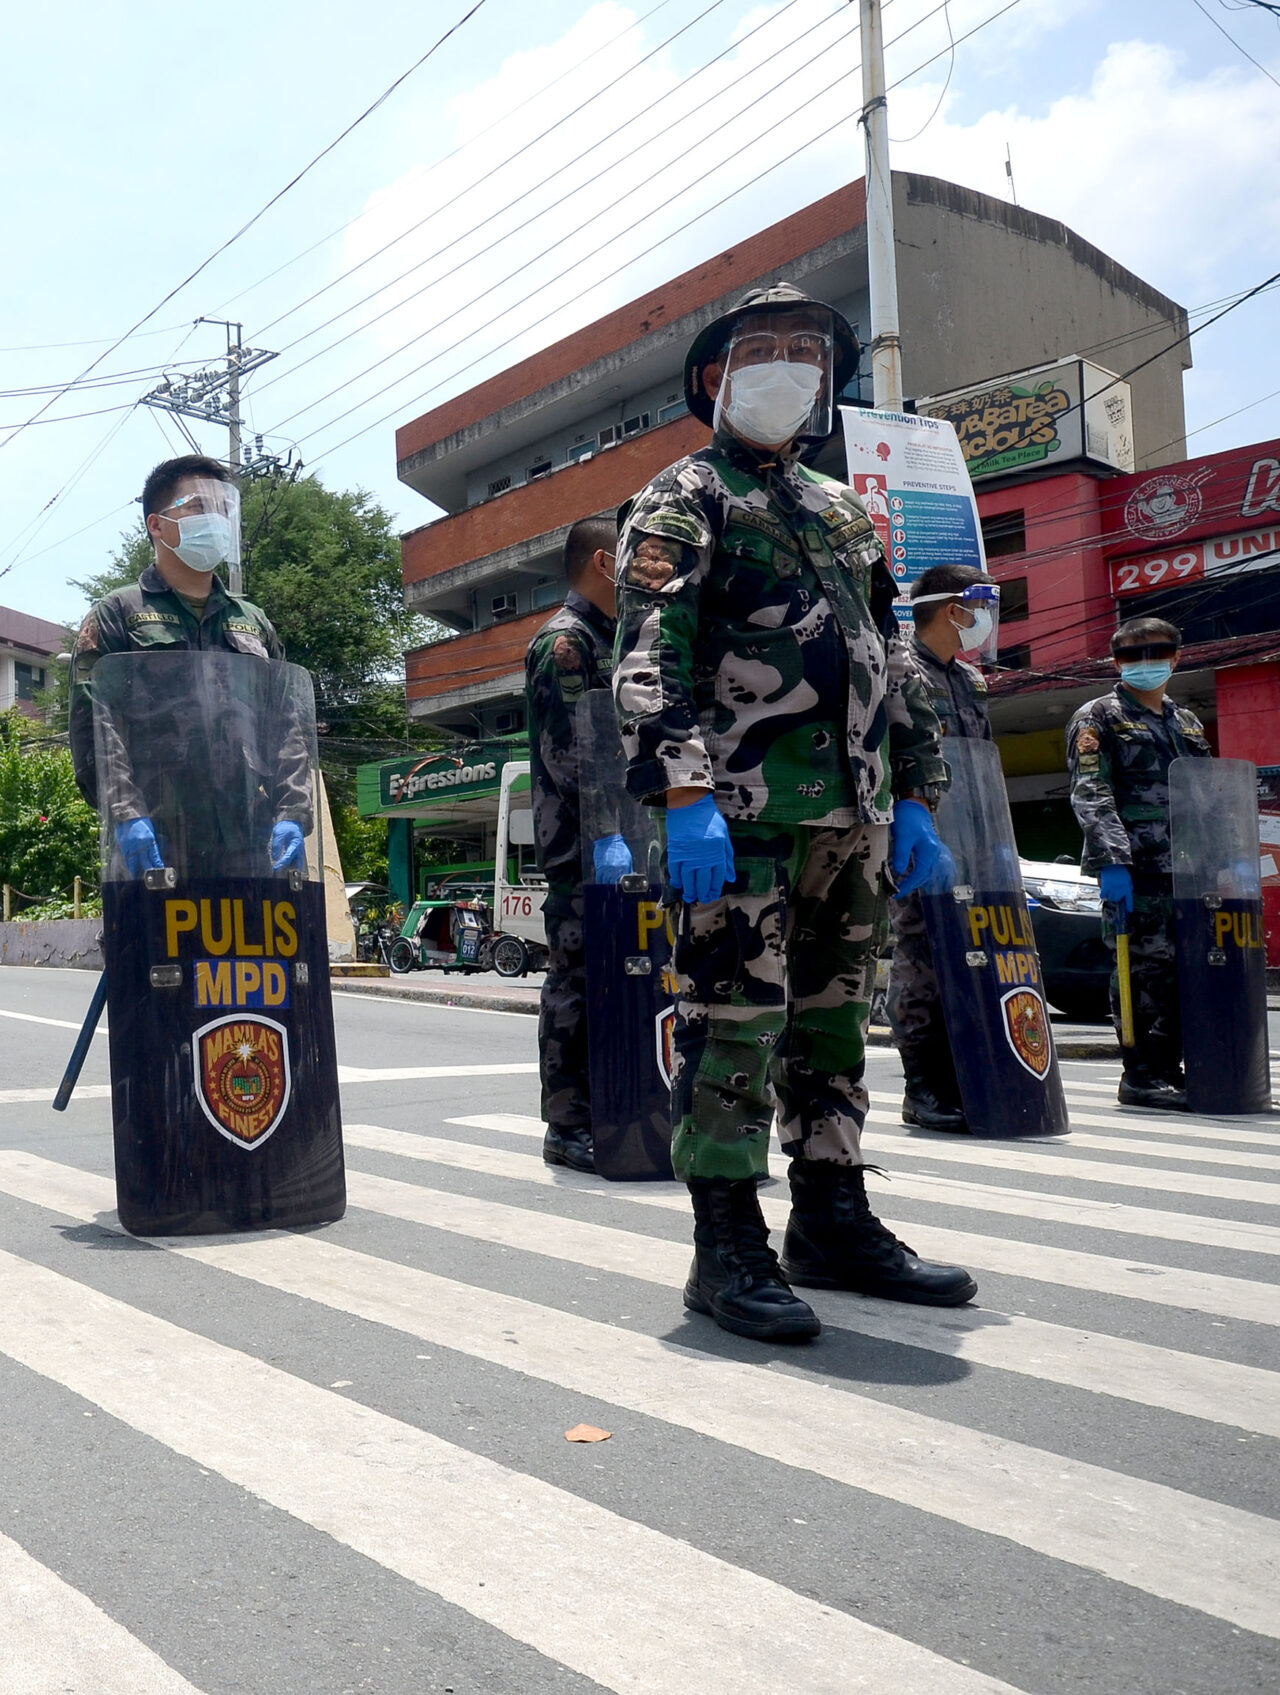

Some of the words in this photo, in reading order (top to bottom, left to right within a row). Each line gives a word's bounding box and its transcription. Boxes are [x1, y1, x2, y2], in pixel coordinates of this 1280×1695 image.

[860, 408, 917, 425] Prevention
[919, 416, 940, 430] Tips
[980, 457, 1000, 471] Milk
[1001, 455, 1017, 464] Tea
[1017, 448, 1041, 460] Place
[902, 480, 939, 490] PREVENTIVE
[939, 483, 957, 492] STEPS
[1117, 553, 1198, 590] 299
[1215, 530, 1280, 559] UN
[389, 761, 496, 798] Expressions
[503, 896, 532, 917] 176
[165, 898, 299, 958] PULIS
[462, 944, 476, 956] 012
[196, 961, 287, 1006] MPD
[995, 952, 1039, 984] MPD
[218, 1098, 275, 1138] FINEST
